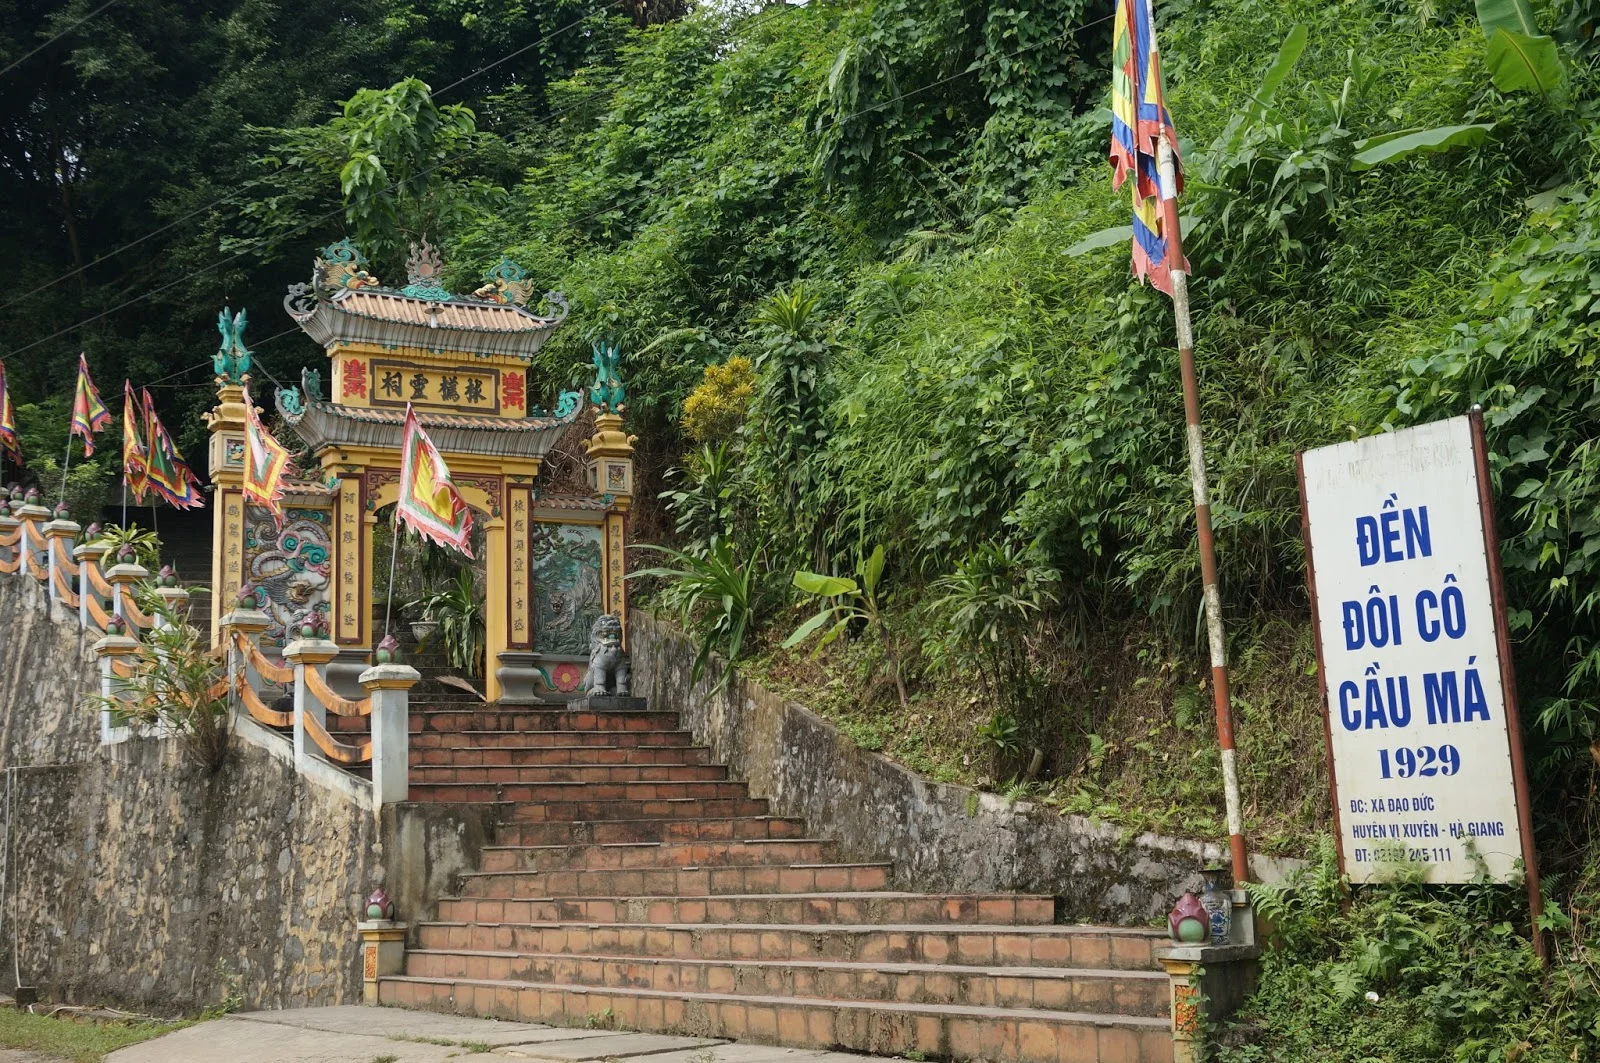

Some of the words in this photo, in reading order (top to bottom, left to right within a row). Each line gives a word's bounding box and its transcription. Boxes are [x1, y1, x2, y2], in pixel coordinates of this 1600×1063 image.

[1356, 493, 1432, 567] ĐỀN
[1342, 585, 1402, 650] ĐÔI
[1415, 574, 1466, 642] CÔ
[1339, 662, 1411, 731] CẦU
[1423, 656, 1491, 725] MÁ
[1377, 744, 1460, 779] 1929
[1350, 799, 1368, 813] ĐC:
[1388, 797, 1409, 815] ĐẠO
[1412, 793, 1435, 812] ĐỨC
[1352, 821, 1386, 841] HUYỆN
[1389, 824, 1400, 841] VỊ
[1403, 820, 1438, 838] XUYÊN
[1449, 819, 1465, 838] HÀ
[1468, 821, 1505, 837] GIANG
[1355, 848, 1371, 862] ĐT:
[1432, 847, 1452, 862] 111
